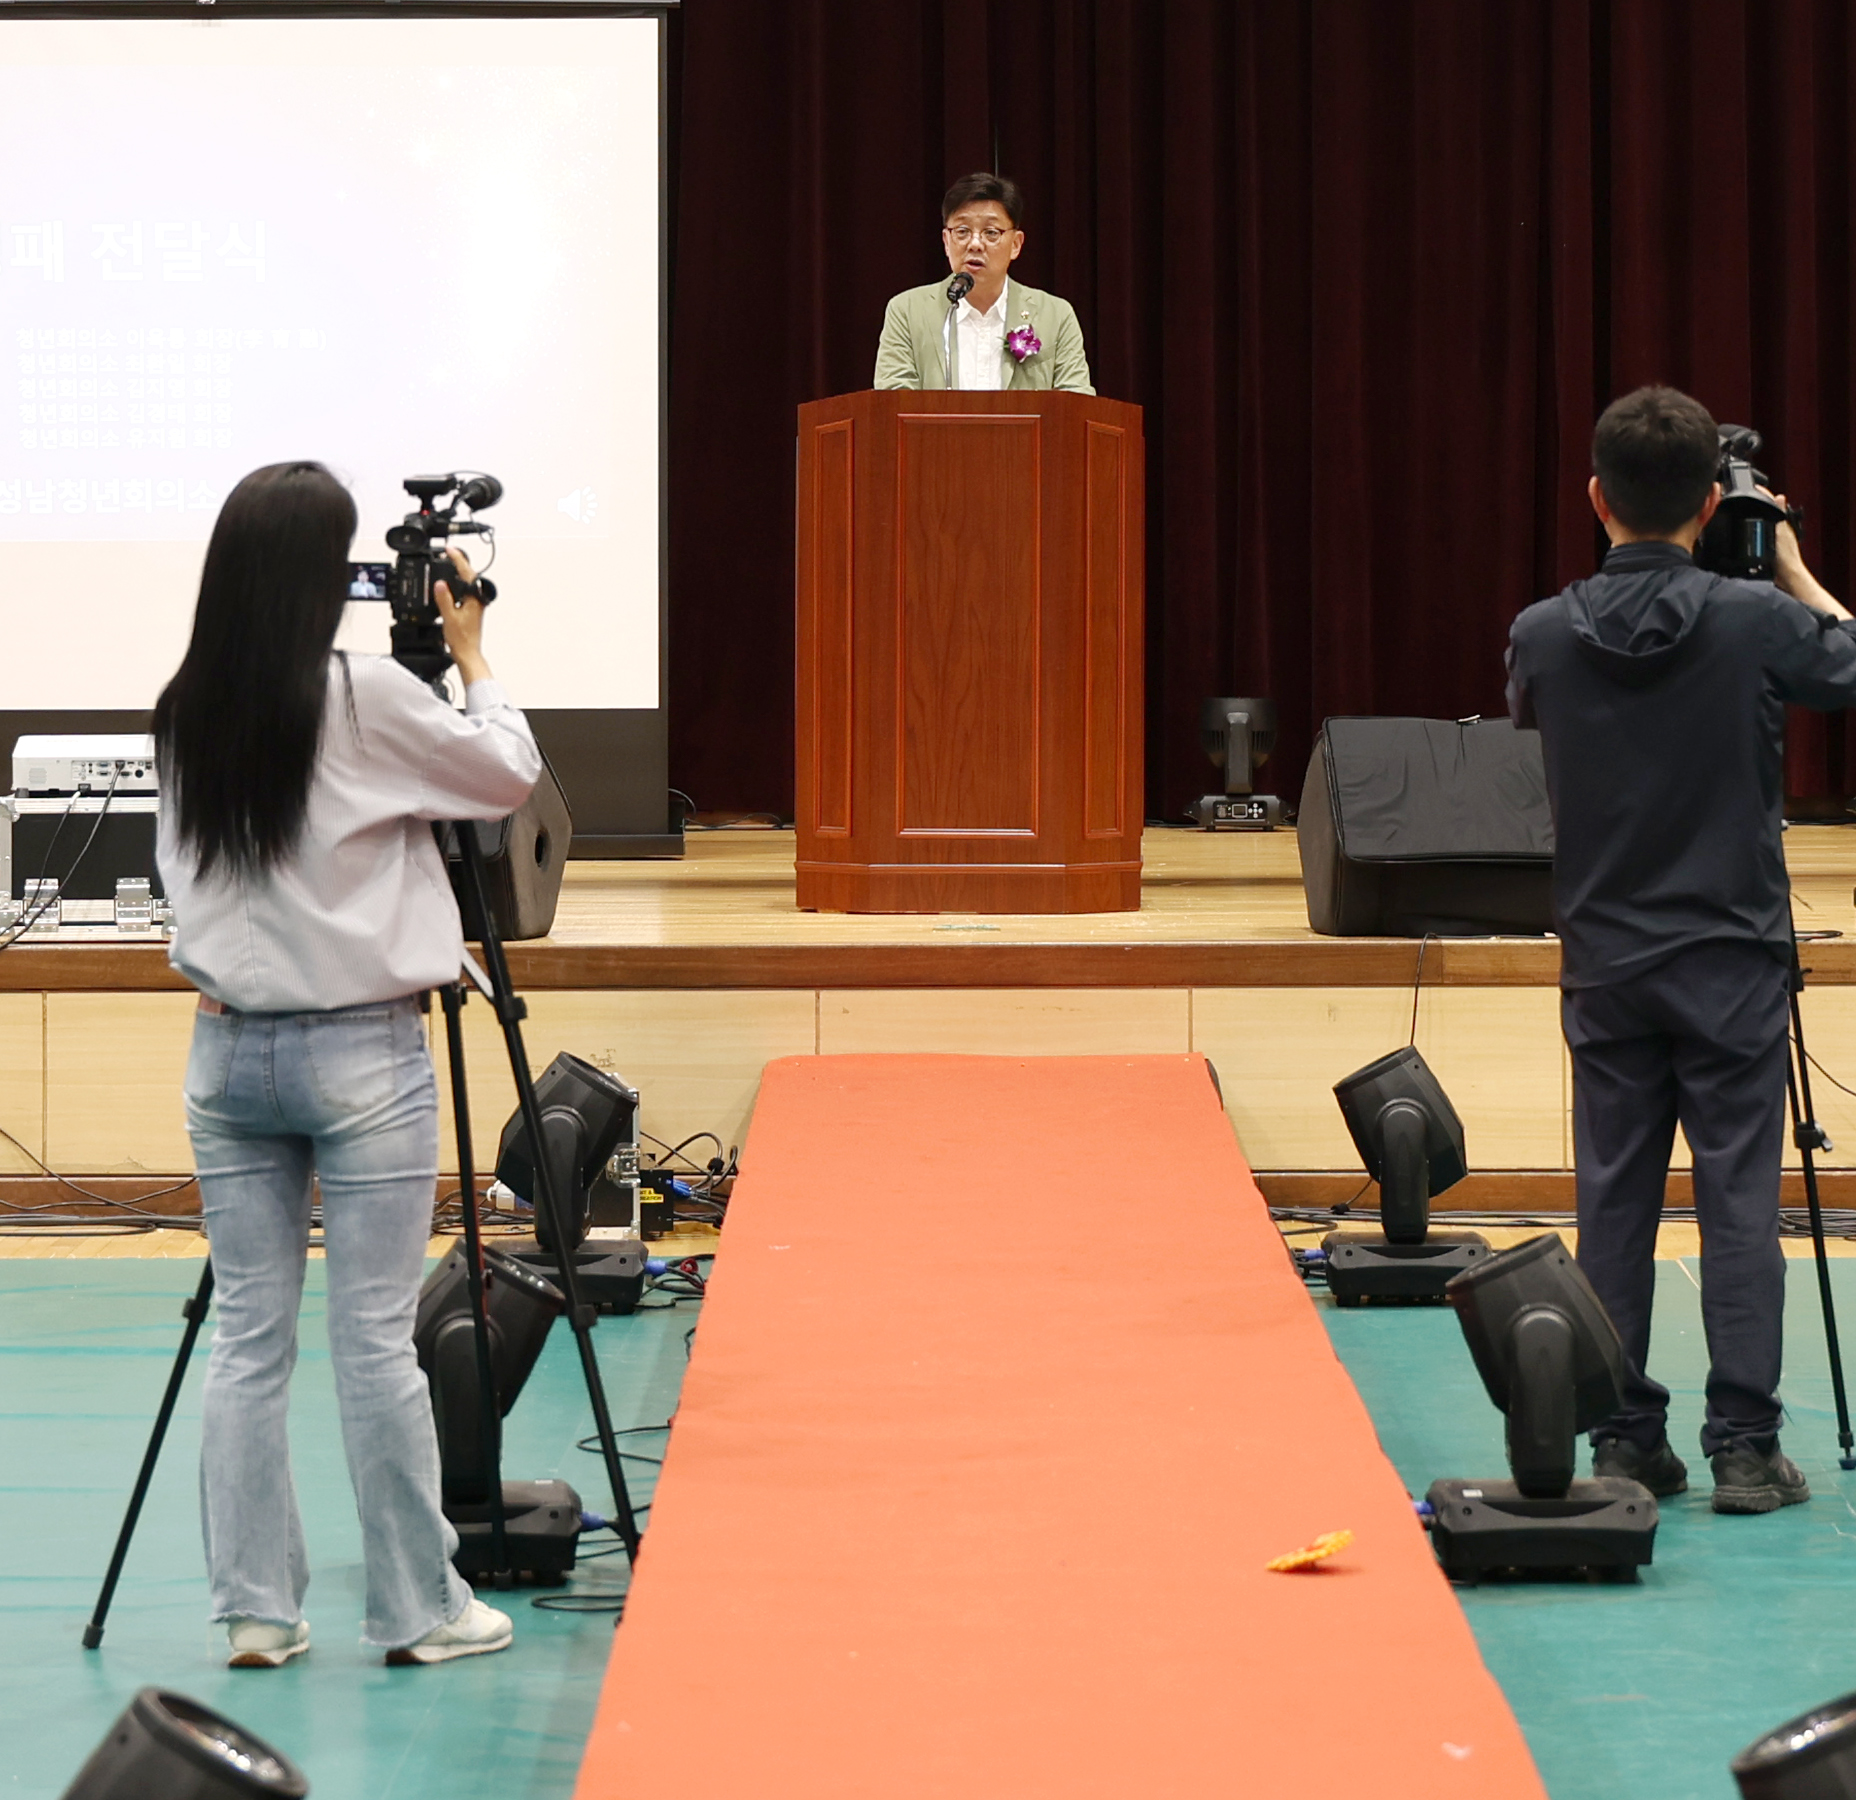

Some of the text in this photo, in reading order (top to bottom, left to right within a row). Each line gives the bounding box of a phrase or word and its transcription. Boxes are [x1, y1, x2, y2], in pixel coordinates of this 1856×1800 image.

[89, 218, 269, 285] 전달식
[15, 326, 119, 351] 청년회의소
[16, 352, 120, 376] 청년회의소
[192, 352, 234, 376] 회장
[17, 377, 120, 400] 청년회의소
[192, 377, 234, 400] 회장
[17, 402, 120, 426] 청년회의소
[192, 402, 234, 426] 회장
[18, 426, 121, 450] 청년회의소
[192, 426, 234, 450] 회장
